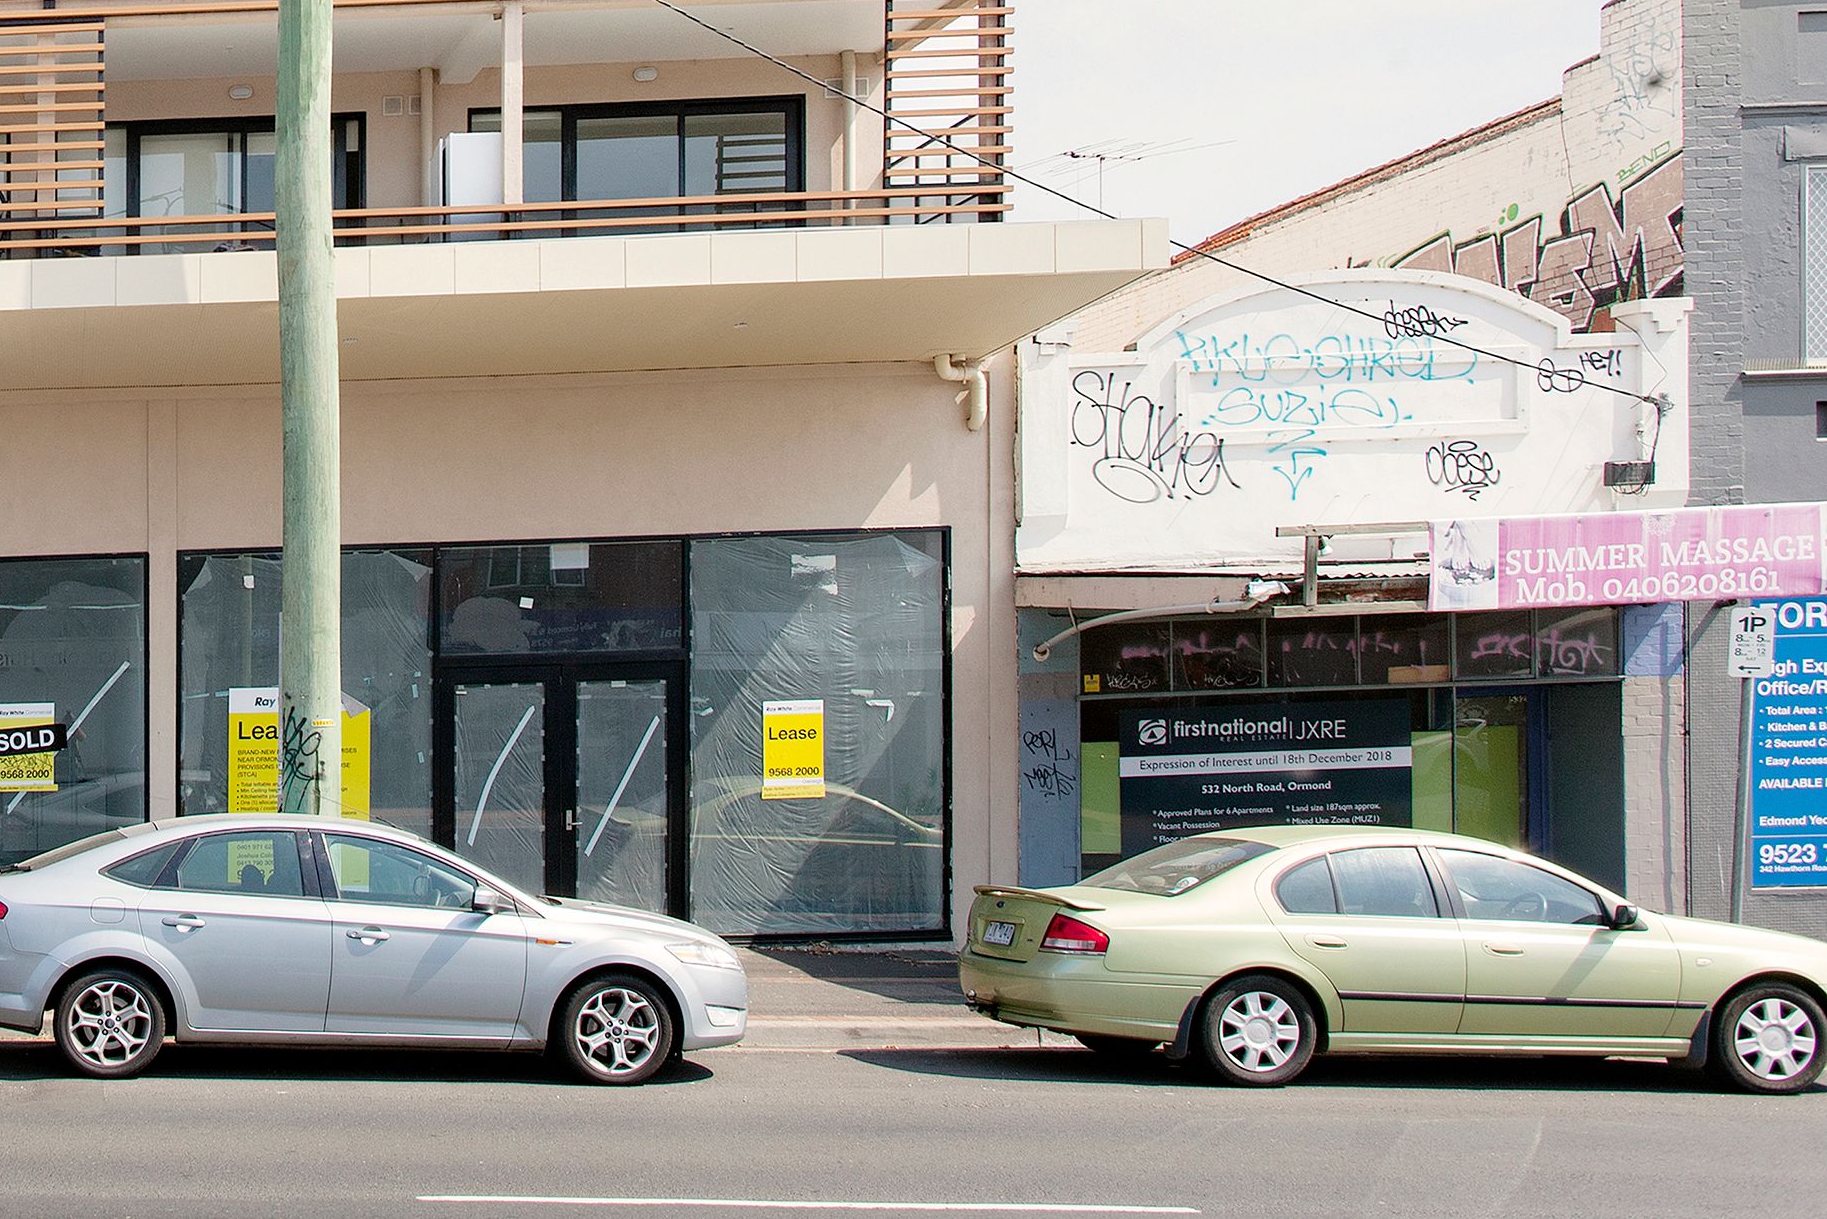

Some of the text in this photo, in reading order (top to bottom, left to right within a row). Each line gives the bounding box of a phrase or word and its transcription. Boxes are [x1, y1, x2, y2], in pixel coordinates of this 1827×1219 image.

[1505, 534, 1816, 576] SUMMER MASSAGE
[1516, 567, 1780, 604] Mob. 0406208161
[1759, 602, 1827, 629] OR
[1738, 617, 1767, 632] 1P
[1772, 659, 1798, 677] igh
[254, 697, 276, 707] Ray
[1765, 705, 1817, 716] Total Area
[1173, 717, 1347, 741] firstnational JXRE
[1767, 721, 1818, 732] Kitchen &
[768, 726, 818, 741] Lease
[1251, 734, 1287, 742] ESTATE
[1765, 738, 1817, 748] 2 Secured
[1139, 750, 1392, 772] Expression of Interest until 18th December 2018
[1765, 756, 1791, 767] Easy
[0, 769, 50, 779] 9568 2000
[768, 766, 820, 777] 9568 2000
[1201, 781, 1332, 794] 532 North Road, Ormond
[1758, 777, 1823, 789] AVAILABLE
[1156, 809, 1193, 818] Approved
[1194, 808, 1212, 816] Plans
[1213, 807, 1224, 815] for
[1232, 807, 1274, 816] Apartments
[1291, 804, 1309, 812] Land
[1310, 804, 1324, 812] size
[1326, 803, 1353, 812] 187sqm
[1157, 821, 1221, 830] Vacant Possession
[1291, 816, 1314, 825] Mixed
[1315, 816, 1329, 824] Use
[1330, 816, 1350, 824] Zone
[1759, 815, 1807, 826] Edmond
[1759, 843, 1818, 865] 9523
[1774, 865, 1811, 873] Hawthorn
